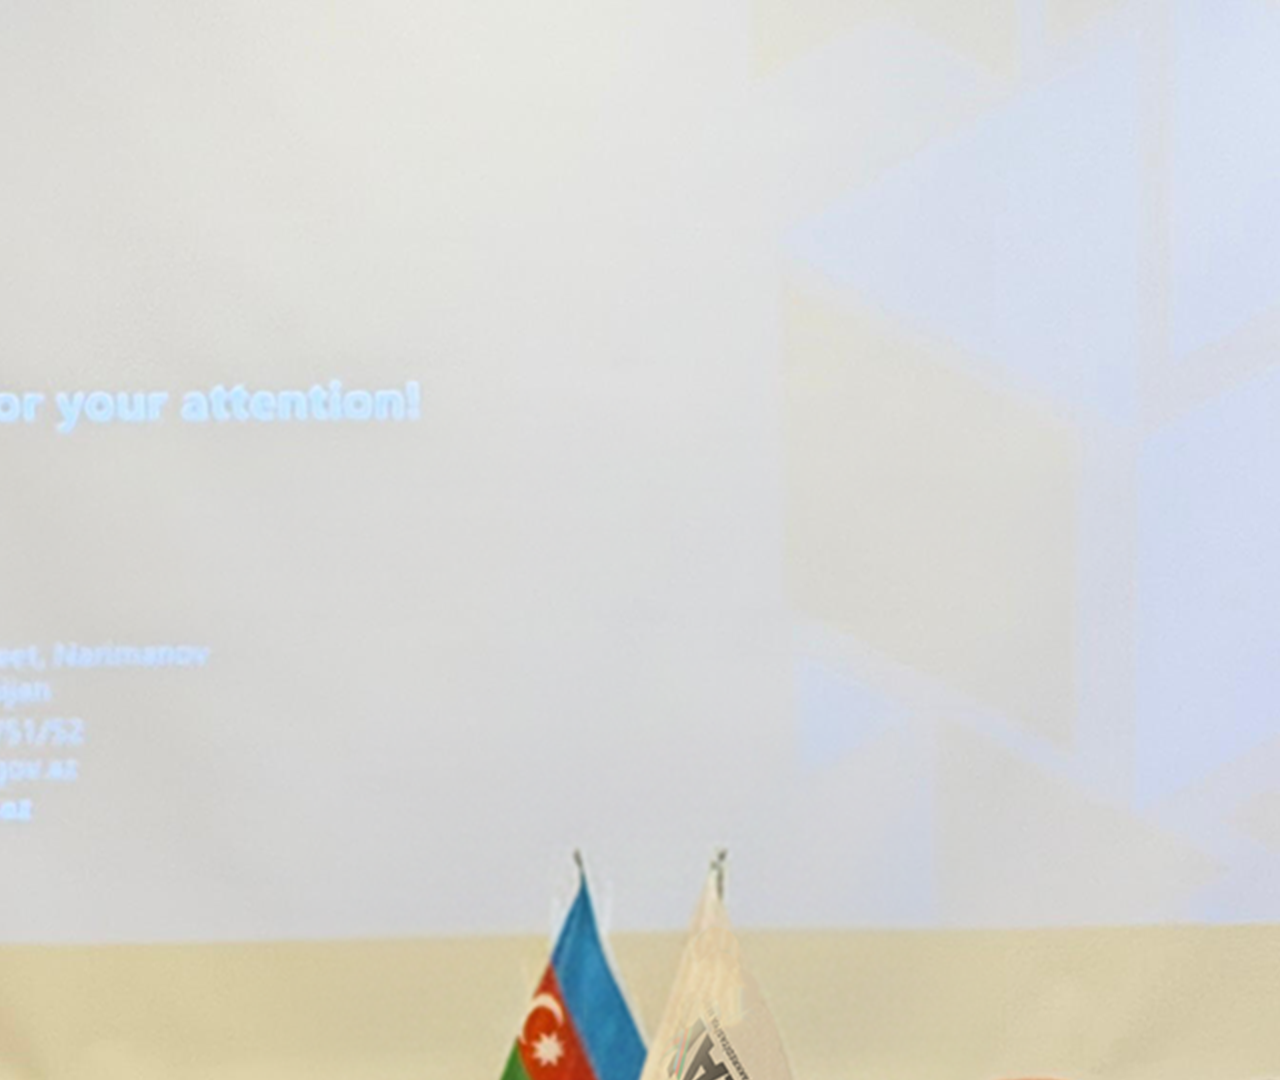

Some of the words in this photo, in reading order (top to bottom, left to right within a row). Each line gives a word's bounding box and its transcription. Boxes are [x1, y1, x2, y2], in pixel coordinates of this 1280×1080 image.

[55, 391, 169, 435] your
[181, 379, 421, 424] attention!
[50, 641, 210, 669] Narimanov
